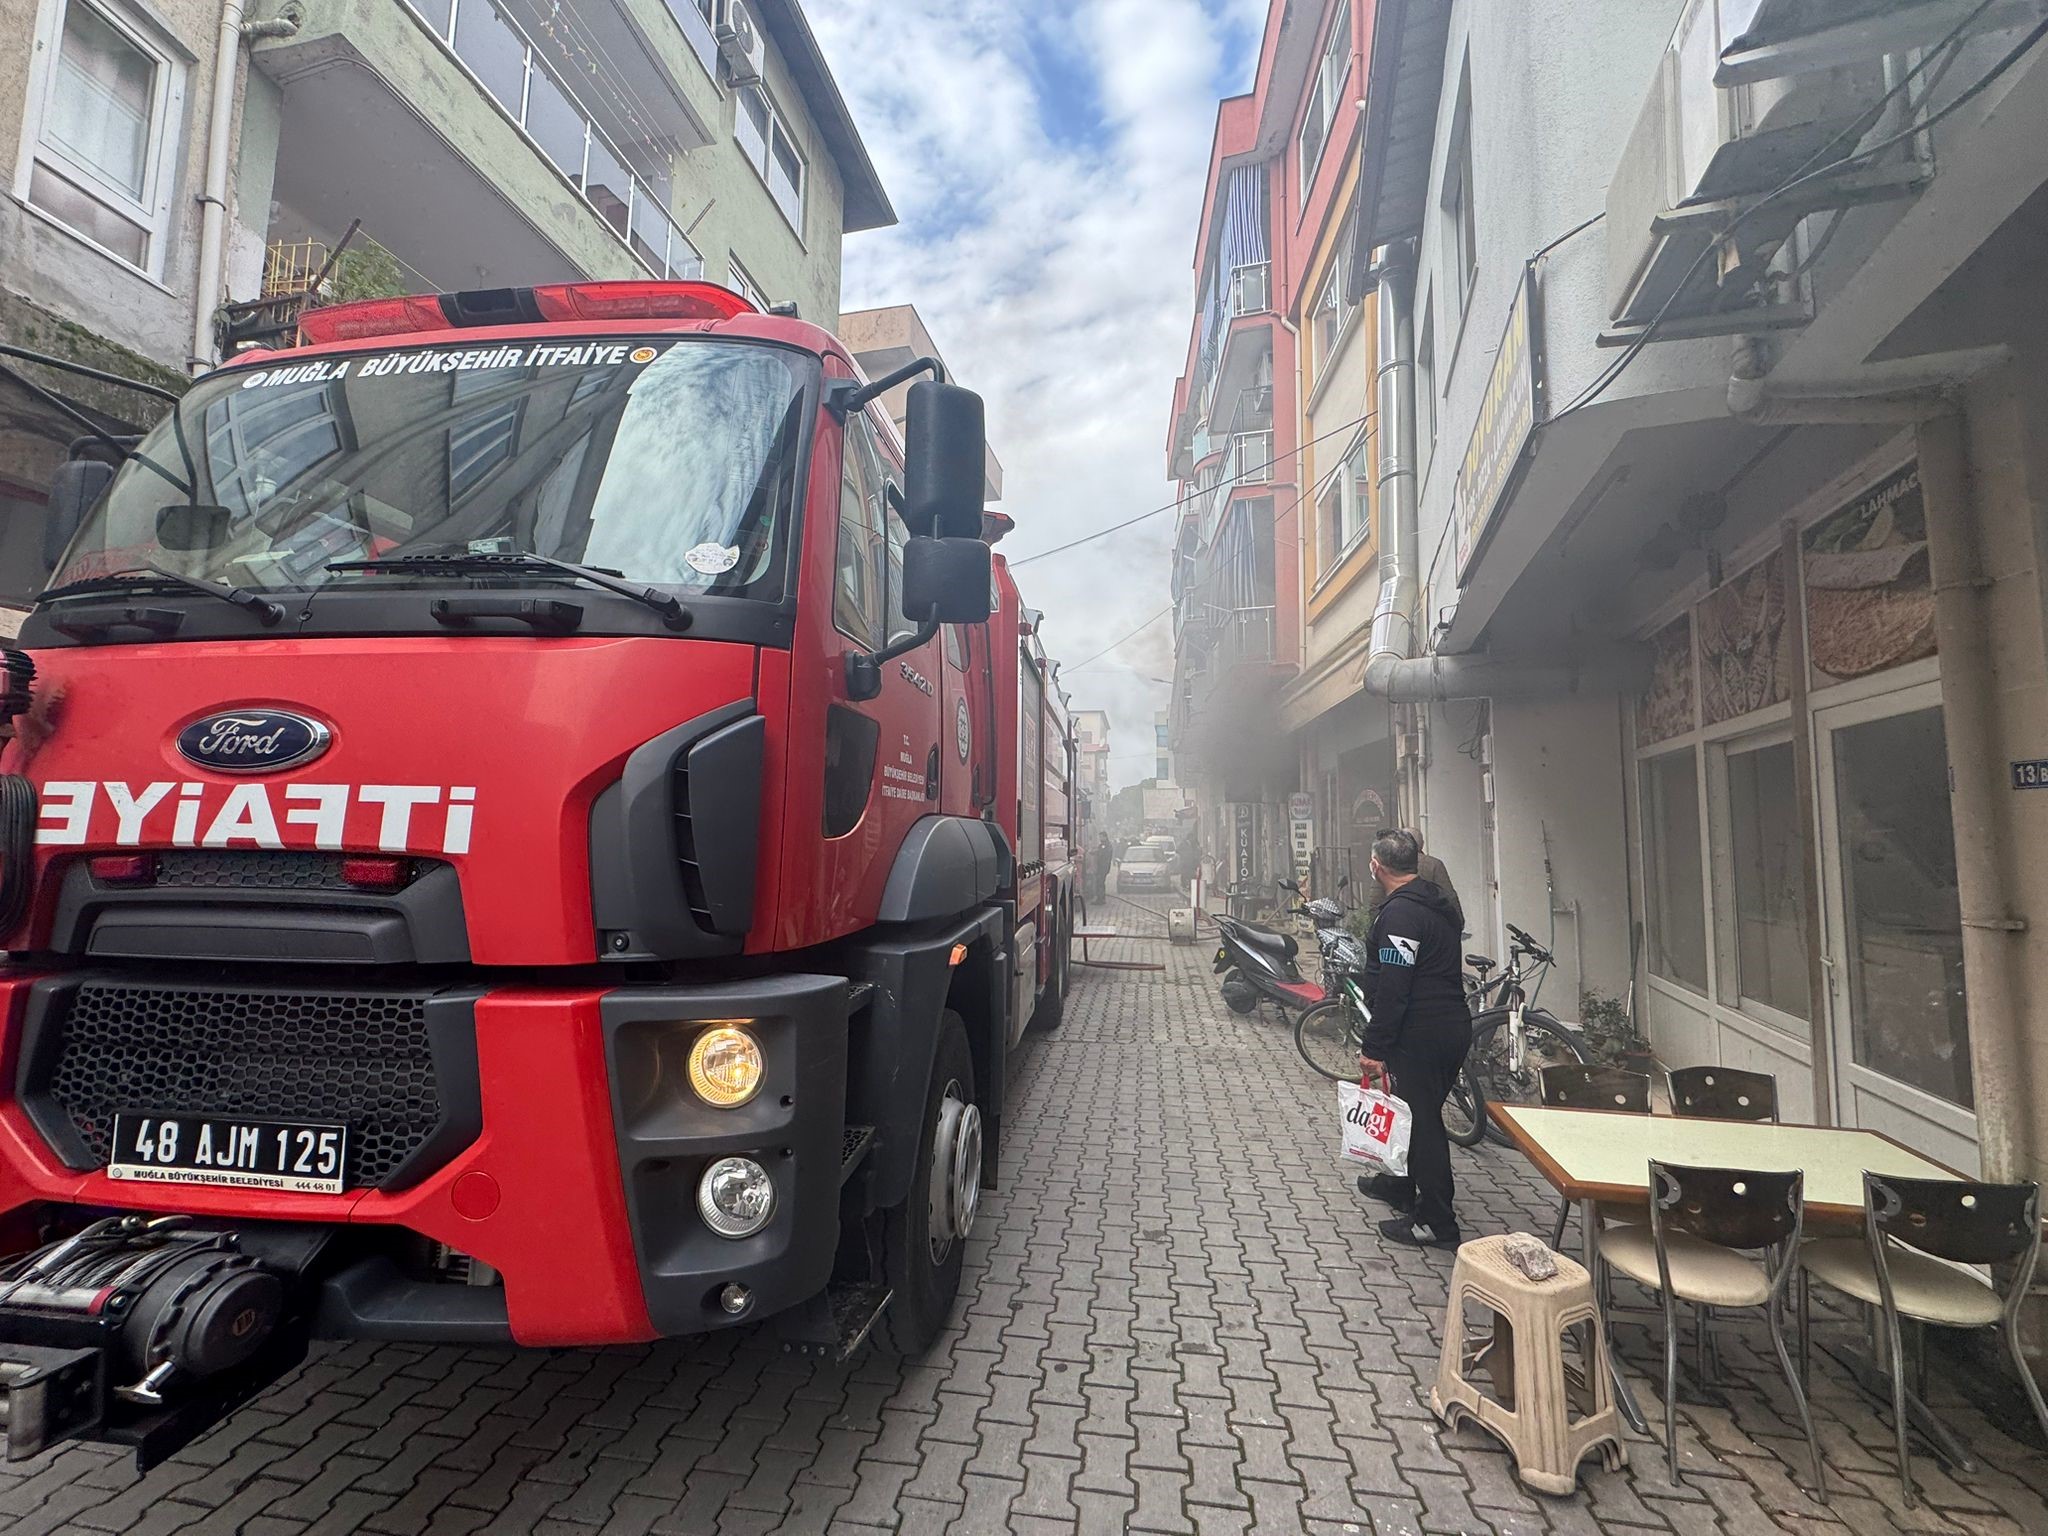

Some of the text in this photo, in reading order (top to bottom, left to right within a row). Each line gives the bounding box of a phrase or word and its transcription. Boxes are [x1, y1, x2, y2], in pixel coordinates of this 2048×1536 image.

[262, 342, 630, 388] MUĞLA BÜYÜKŞEHİR İTFAİYE
[1466, 291, 1524, 490] DOYURAN
[199, 717, 286, 756] Ford
[1346, 1100, 1387, 1137] dagi
[135, 1119, 338, 1175] 48 AJM 125
[133, 1170, 336, 1192] MUĞLA BÜYÜKŞEHİR BELEDİYESİ 444 48 01
